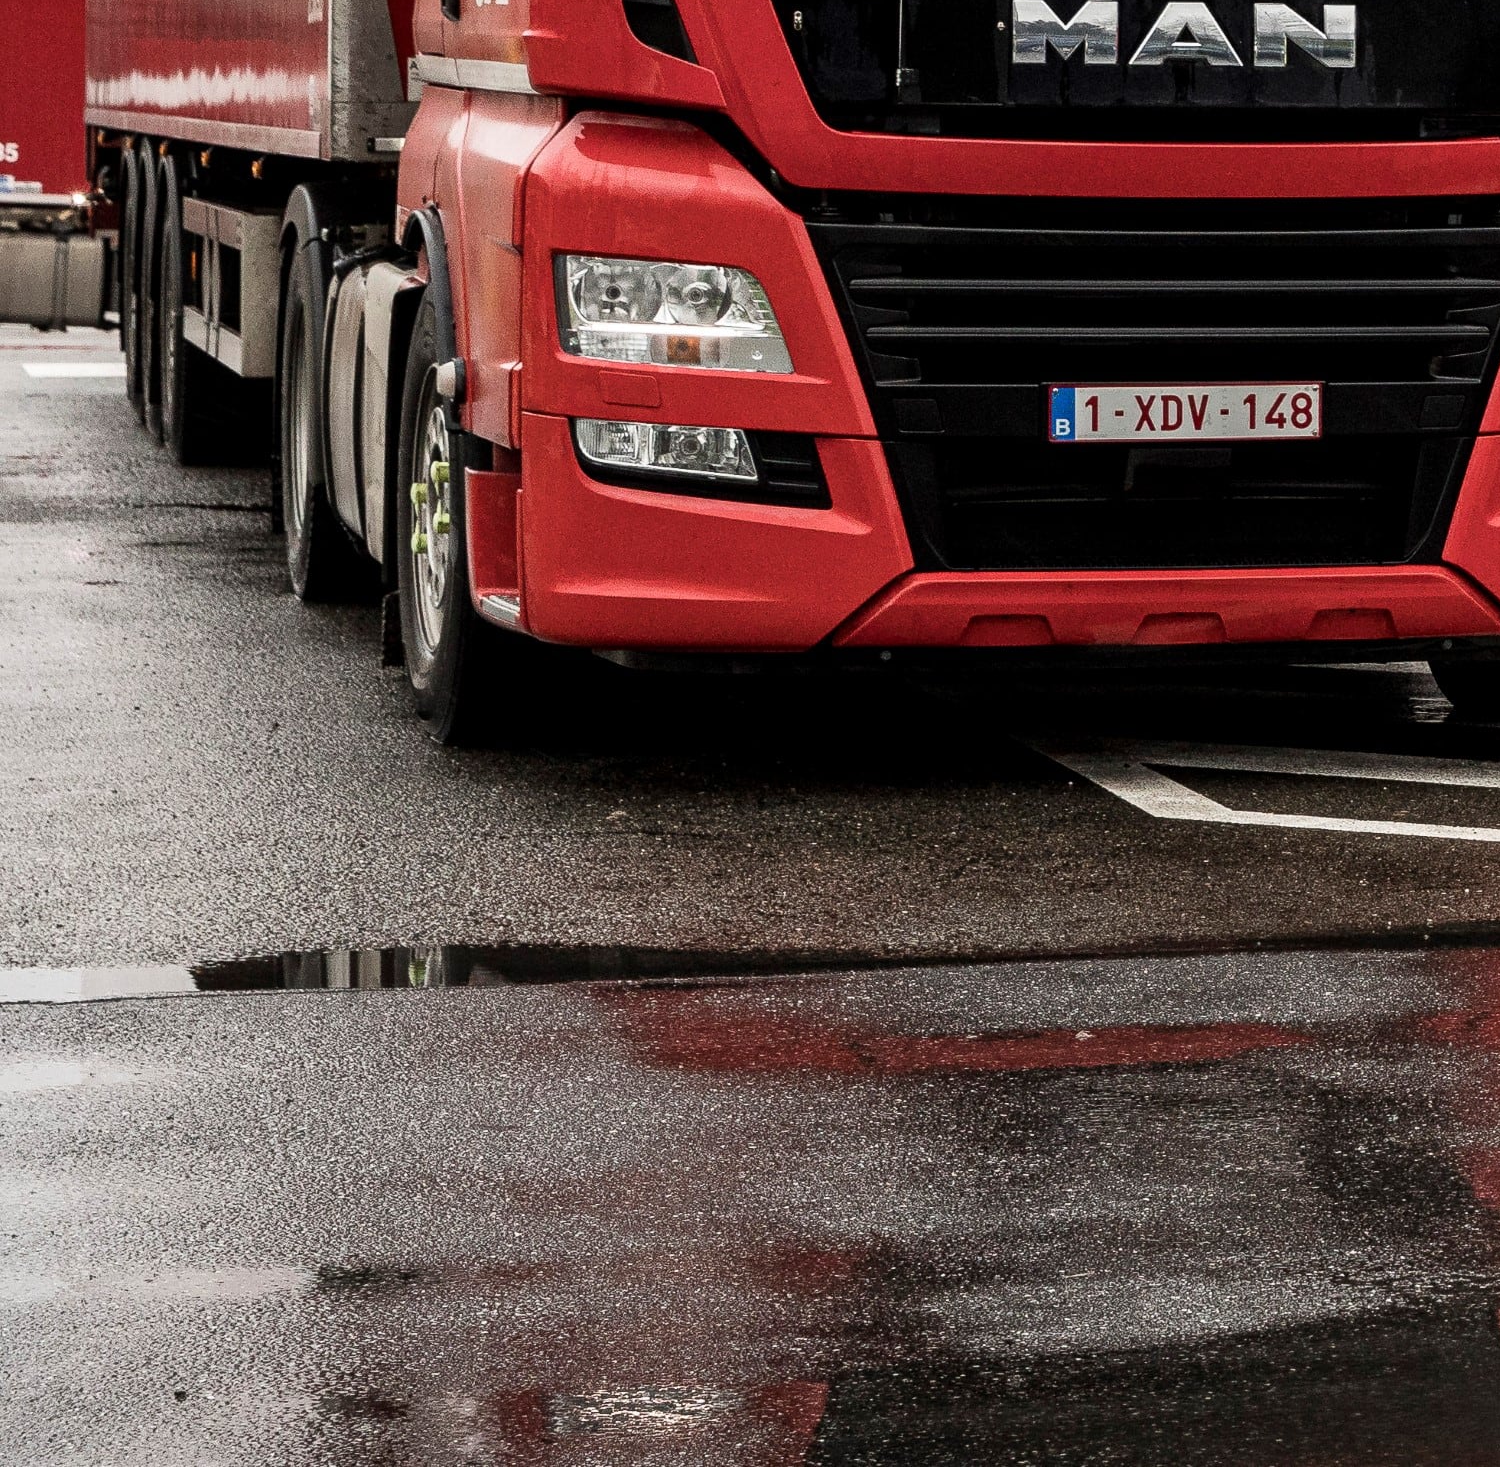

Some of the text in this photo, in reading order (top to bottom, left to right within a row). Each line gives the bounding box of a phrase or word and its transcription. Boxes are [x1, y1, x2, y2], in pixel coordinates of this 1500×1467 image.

[1012, 0, 1356, 68] MAN
[1055, 392, 1313, 436] B 1-XDV-148
